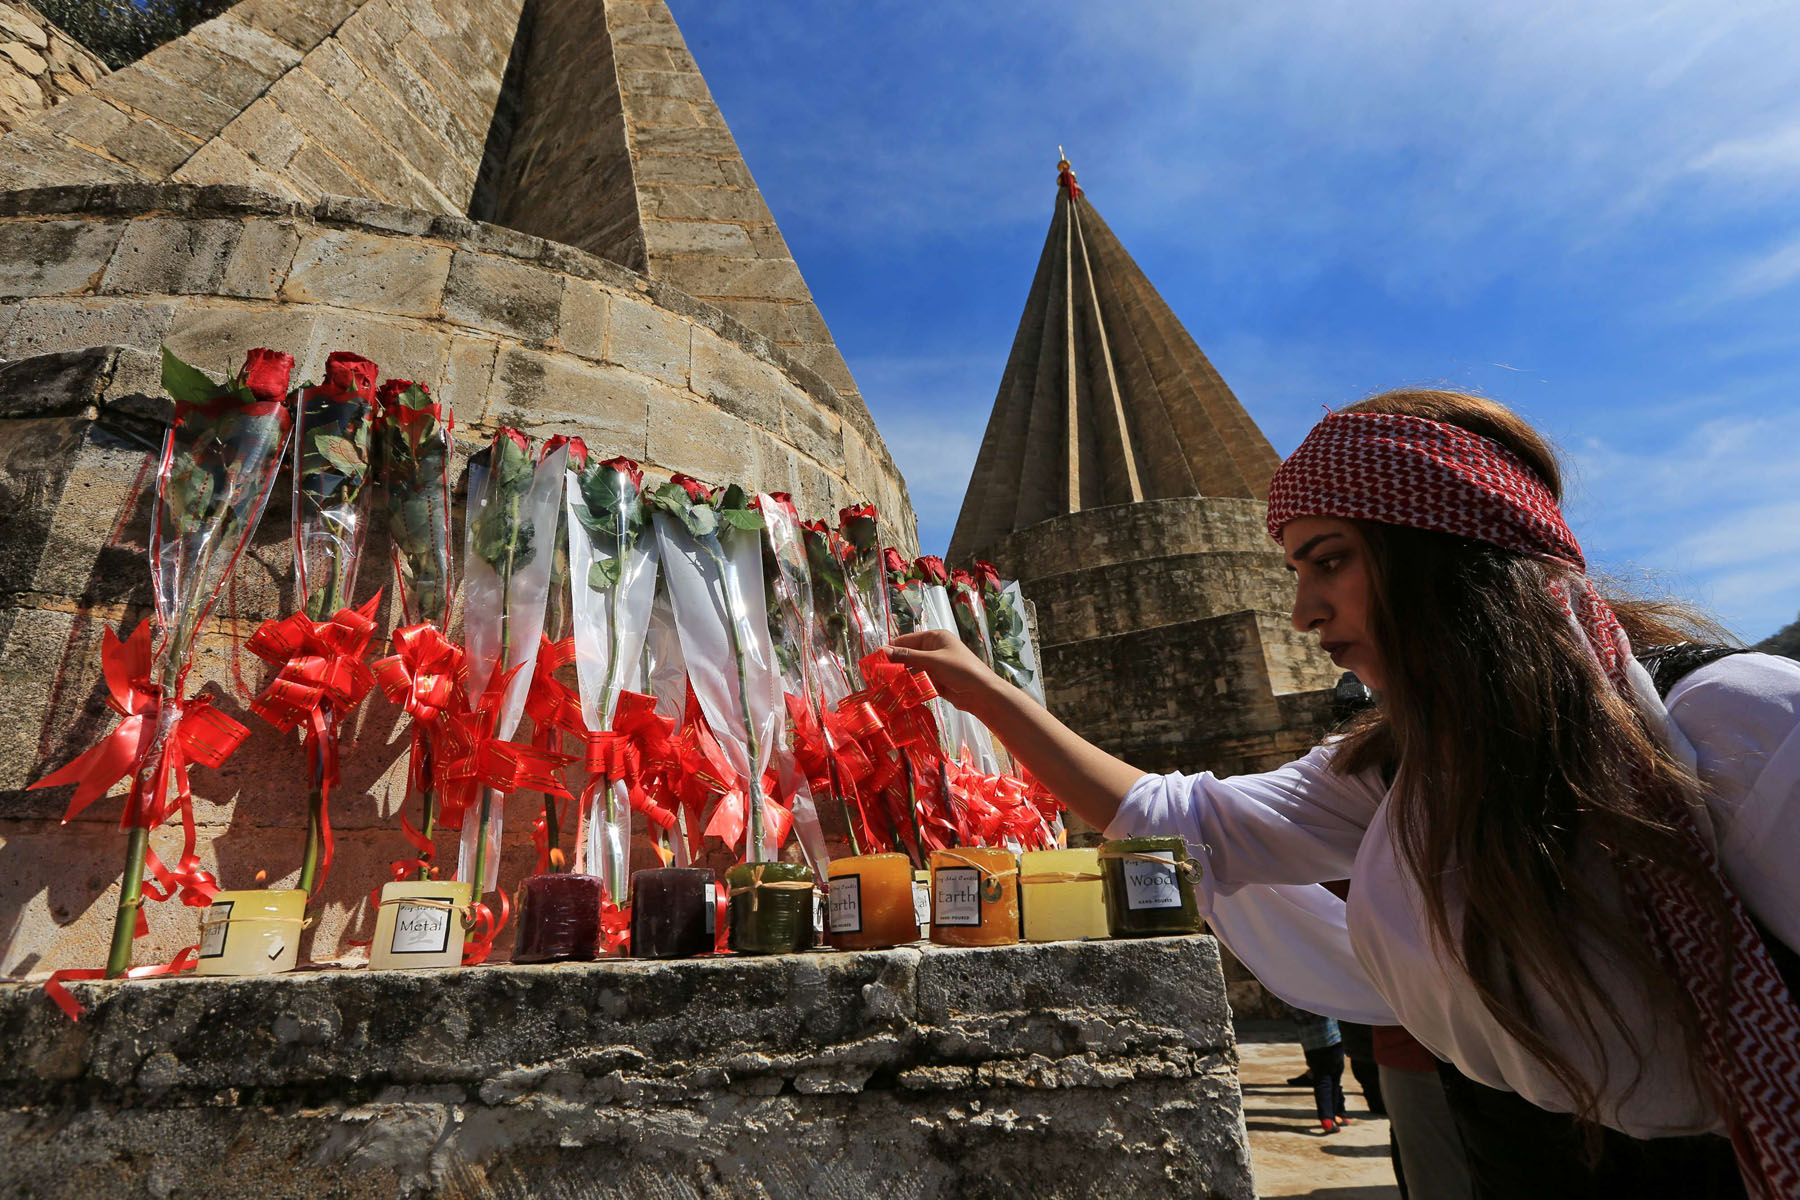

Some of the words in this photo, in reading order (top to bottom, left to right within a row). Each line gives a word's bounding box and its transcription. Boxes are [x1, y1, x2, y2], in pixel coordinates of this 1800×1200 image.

[1130, 868, 1173, 887] Wood
[938, 885, 976, 903] Earth
[400, 916, 443, 932] Metal
